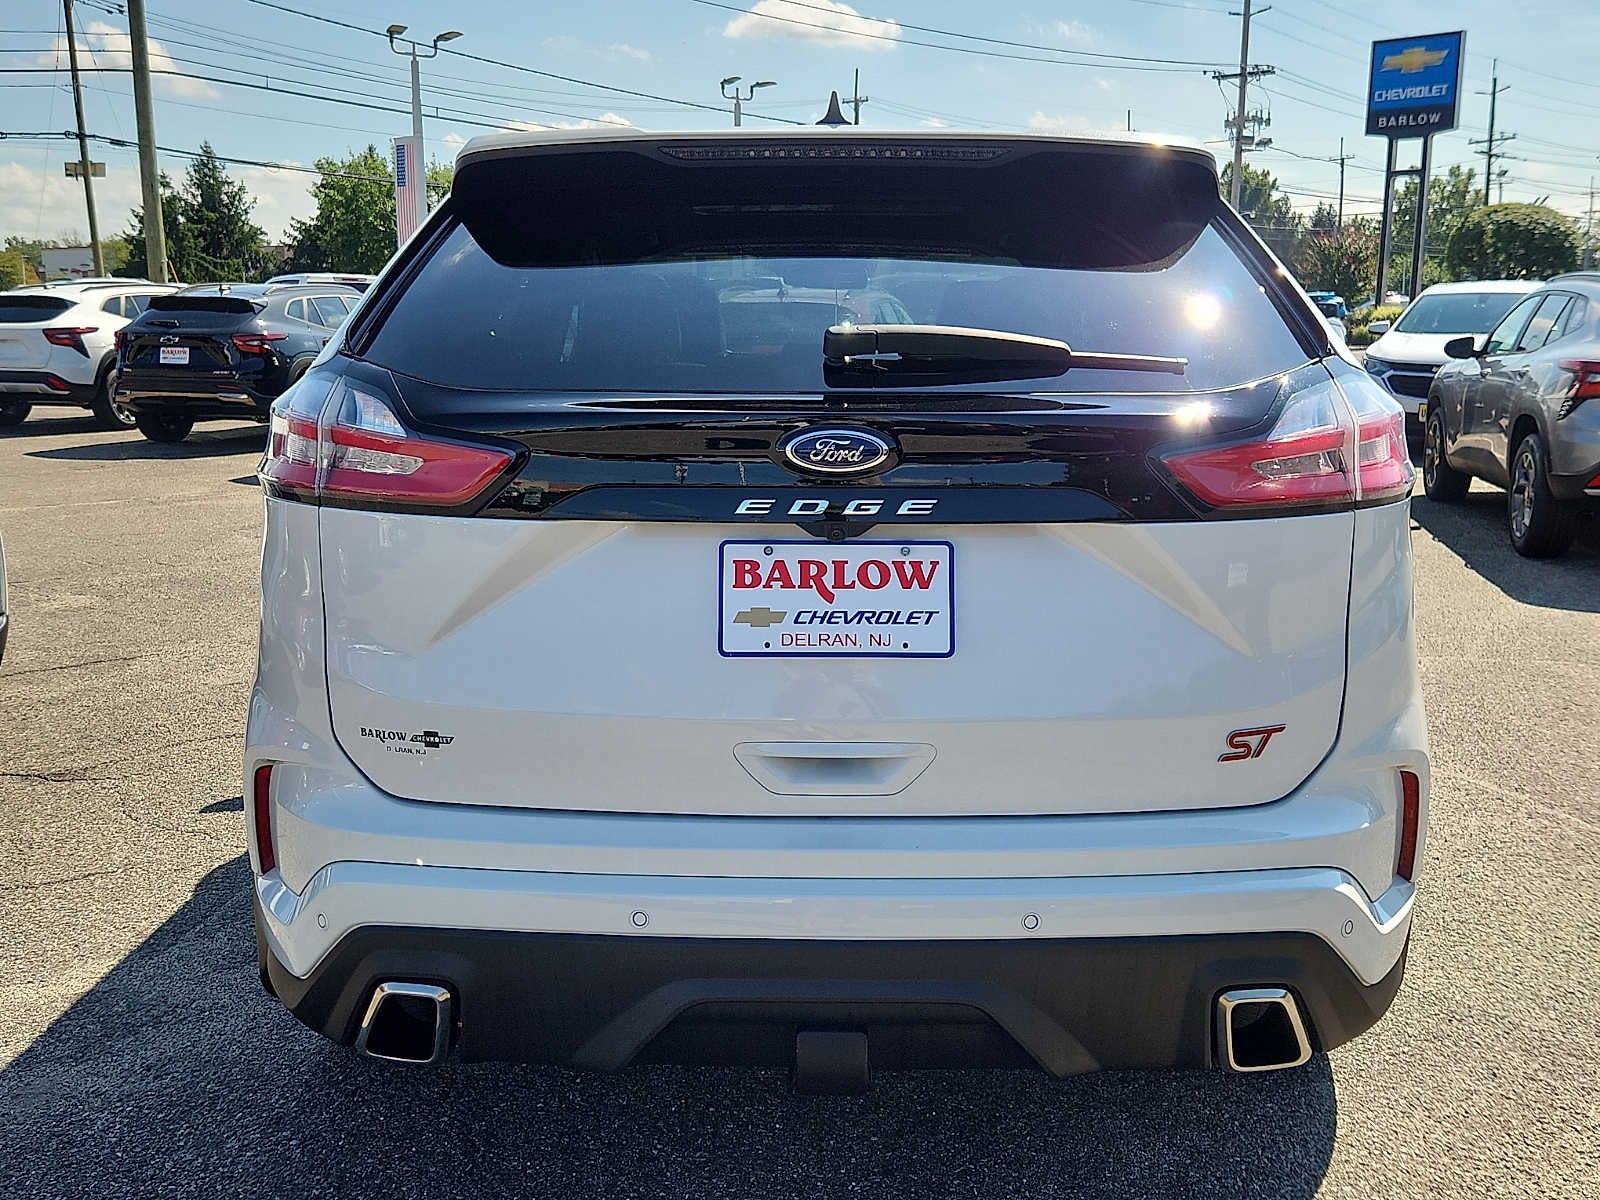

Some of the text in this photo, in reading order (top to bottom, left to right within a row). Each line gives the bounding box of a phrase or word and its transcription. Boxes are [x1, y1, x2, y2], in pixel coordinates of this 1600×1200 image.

[1374, 84, 1449, 102] CHEVROLET
[1378, 112, 1441, 128] BARLOW
[809, 438, 865, 463] Ford
[735, 499, 938, 515] EDGE
[732, 559, 940, 604] BARLOW
[793, 610, 940, 625] CHEVROLET
[781, 633, 892, 648] DELRAN, NJ
[360, 727, 451, 744] BARLOW CHEVROLET
[1217, 723, 1287, 763] ST
[386, 745, 414, 755] DLRAN,
